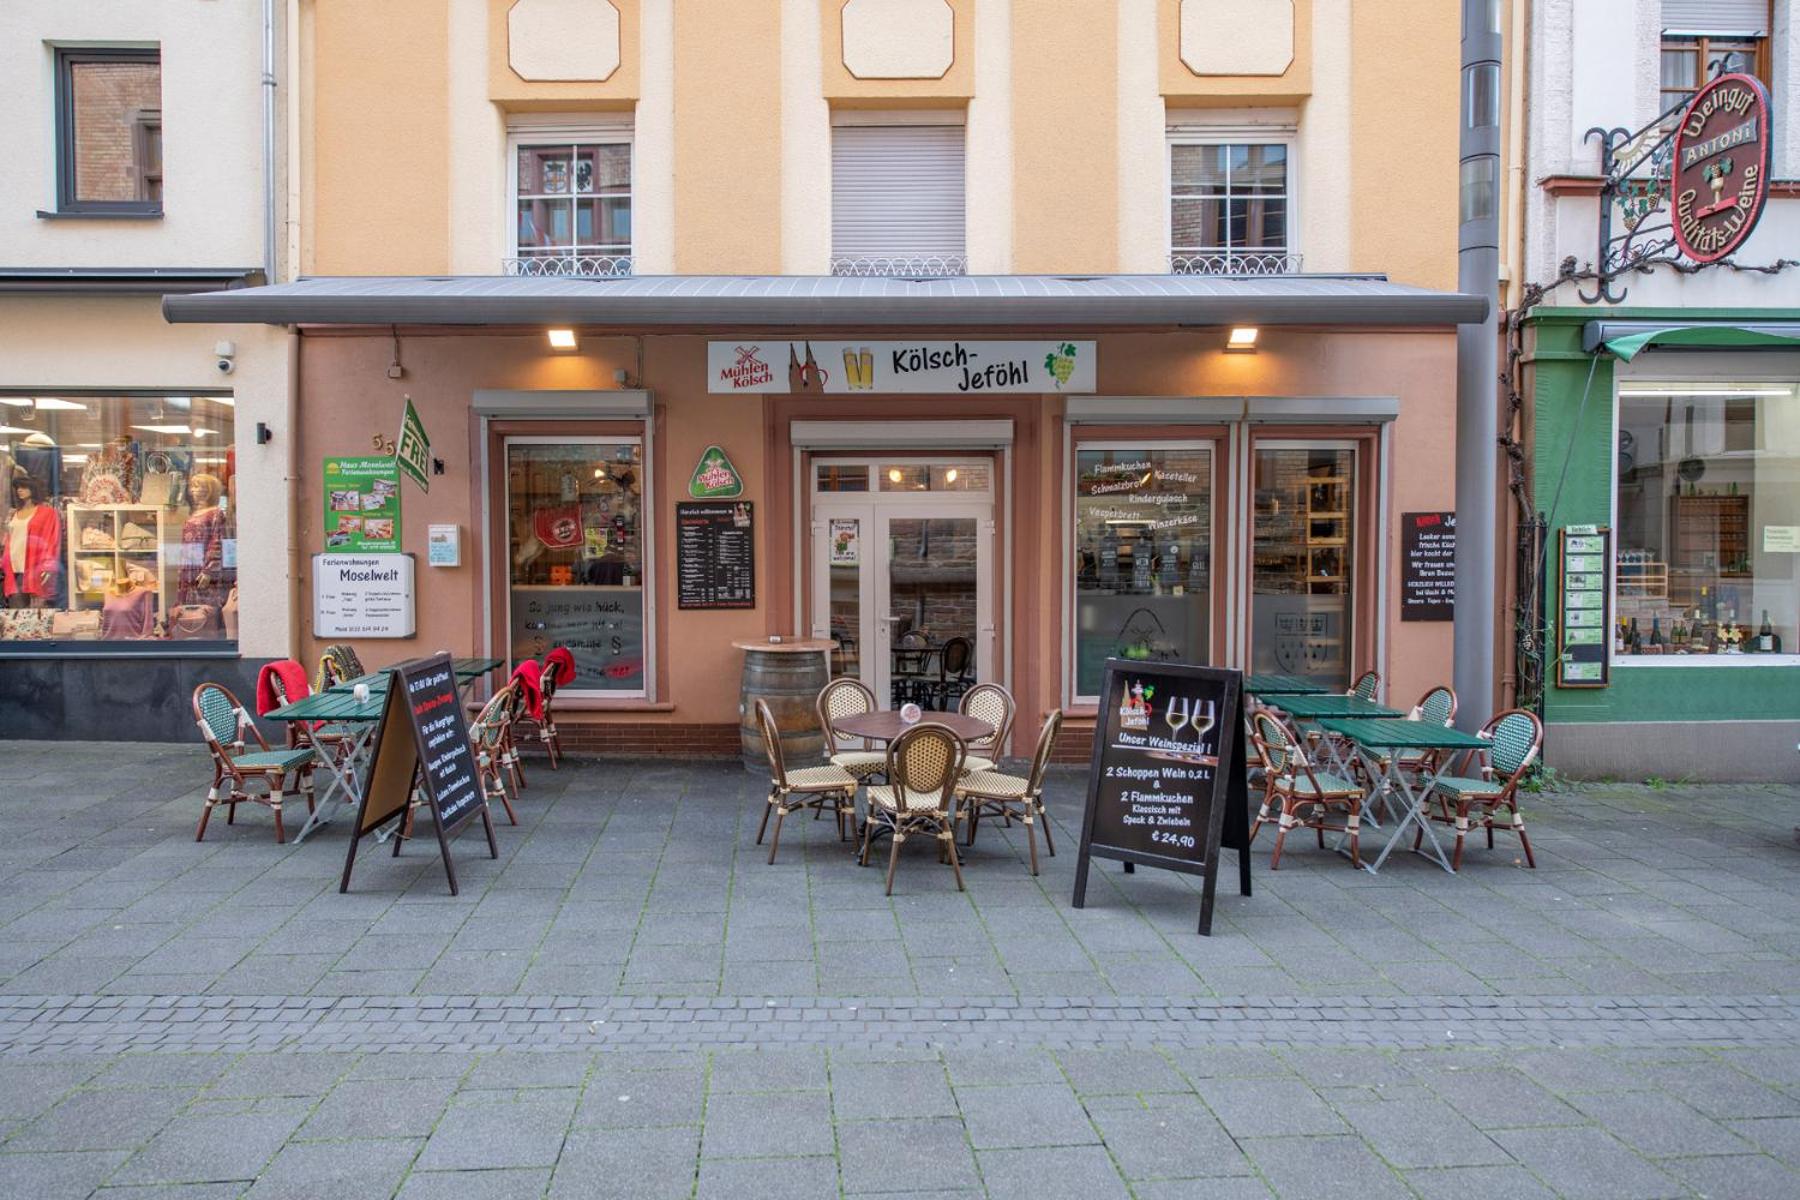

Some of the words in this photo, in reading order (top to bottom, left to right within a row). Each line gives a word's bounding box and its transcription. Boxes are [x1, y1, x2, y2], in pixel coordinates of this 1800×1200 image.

[1683, 86, 1755, 138] Weingut
[1678, 164, 1759, 251] Qualitäts-Weine
[892, 343, 978, 374] Kölsch-
[720, 363, 769, 380] Mühlen
[958, 361, 1028, 391] Jeföhl
[733, 371, 773, 389] Kölsch
[1094, 461, 1151, 475] Flammkuchen
[1091, 481, 1143, 495] Schmalzbrot
[1128, 494, 1187, 505] Rindergulasch
[1089, 506, 1140, 519] Vesperbrett
[340, 569, 398, 581] Moselwelt
[1119, 732, 1147, 745] Unser
[1149, 736, 1204, 753] Weinspezial
[1105, 766, 1114, 777] 2
[1116, 766, 1159, 779] Schoppen
[1162, 767, 1186, 778] Wein
[1188, 770, 1203, 780] 0,2
[1204, 771, 1210, 779] L
[1153, 780, 1160, 789] &
[1120, 791, 1129, 802] 2
[1130, 791, 1194, 804] Flammkuchen
[1132, 804, 1166, 814] Klassisch
[1168, 805, 1181, 814] mit
[1123, 815, 1145, 825] Speck
[1147, 815, 1155, 825] &
[1156, 816, 1191, 827] Zwiebeln
[1151, 830, 1160, 841] €
[1161, 832, 1195, 847] 24,90
